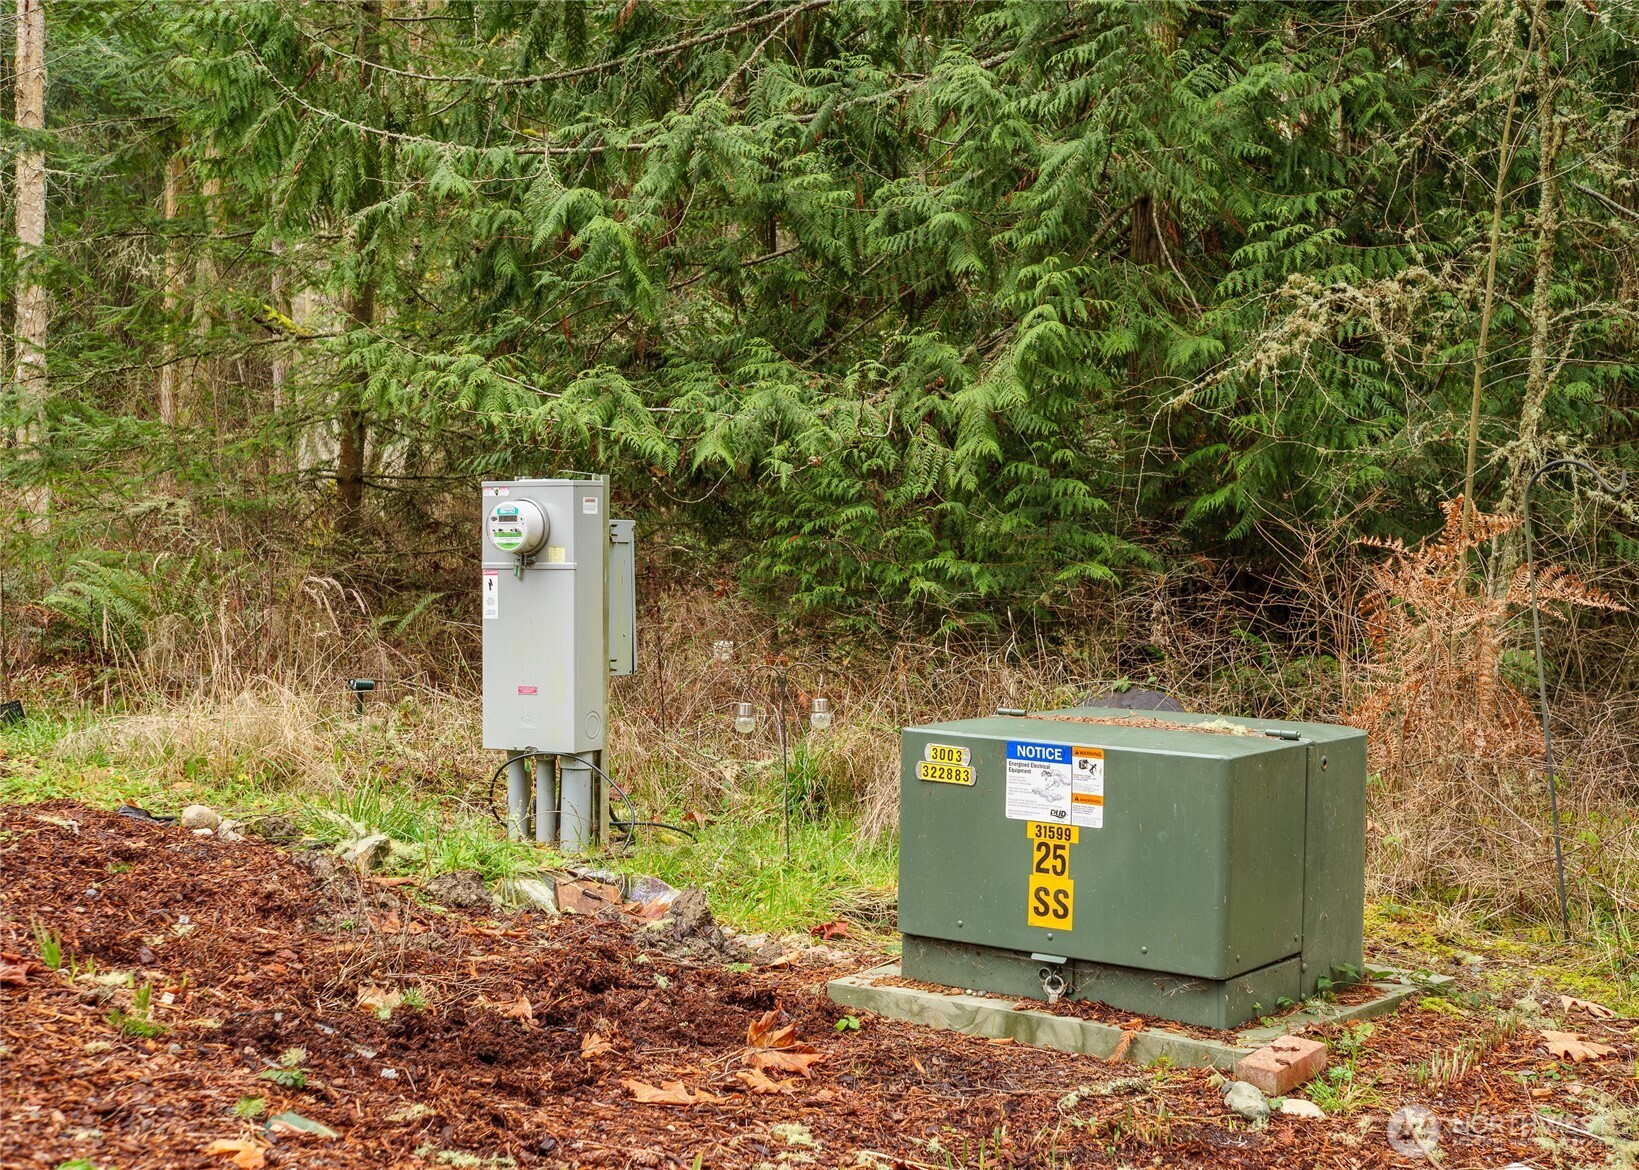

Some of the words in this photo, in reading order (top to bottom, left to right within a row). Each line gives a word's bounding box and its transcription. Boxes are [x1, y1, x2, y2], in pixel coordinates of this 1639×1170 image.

[931, 747, 962, 763] 3003
[1017, 744, 1063, 761] NOTICE
[1079, 749, 1102, 758] WARNING
[922, 764, 970, 782] 322883
[1008, 760, 1030, 769] Energized
[1030, 762, 1051, 770] Electrical
[1008, 767, 1032, 775] Equipment
[1035, 824, 1072, 841] 31599
[1035, 841, 1067, 877] 25
[1033, 886, 1070, 920] SS
